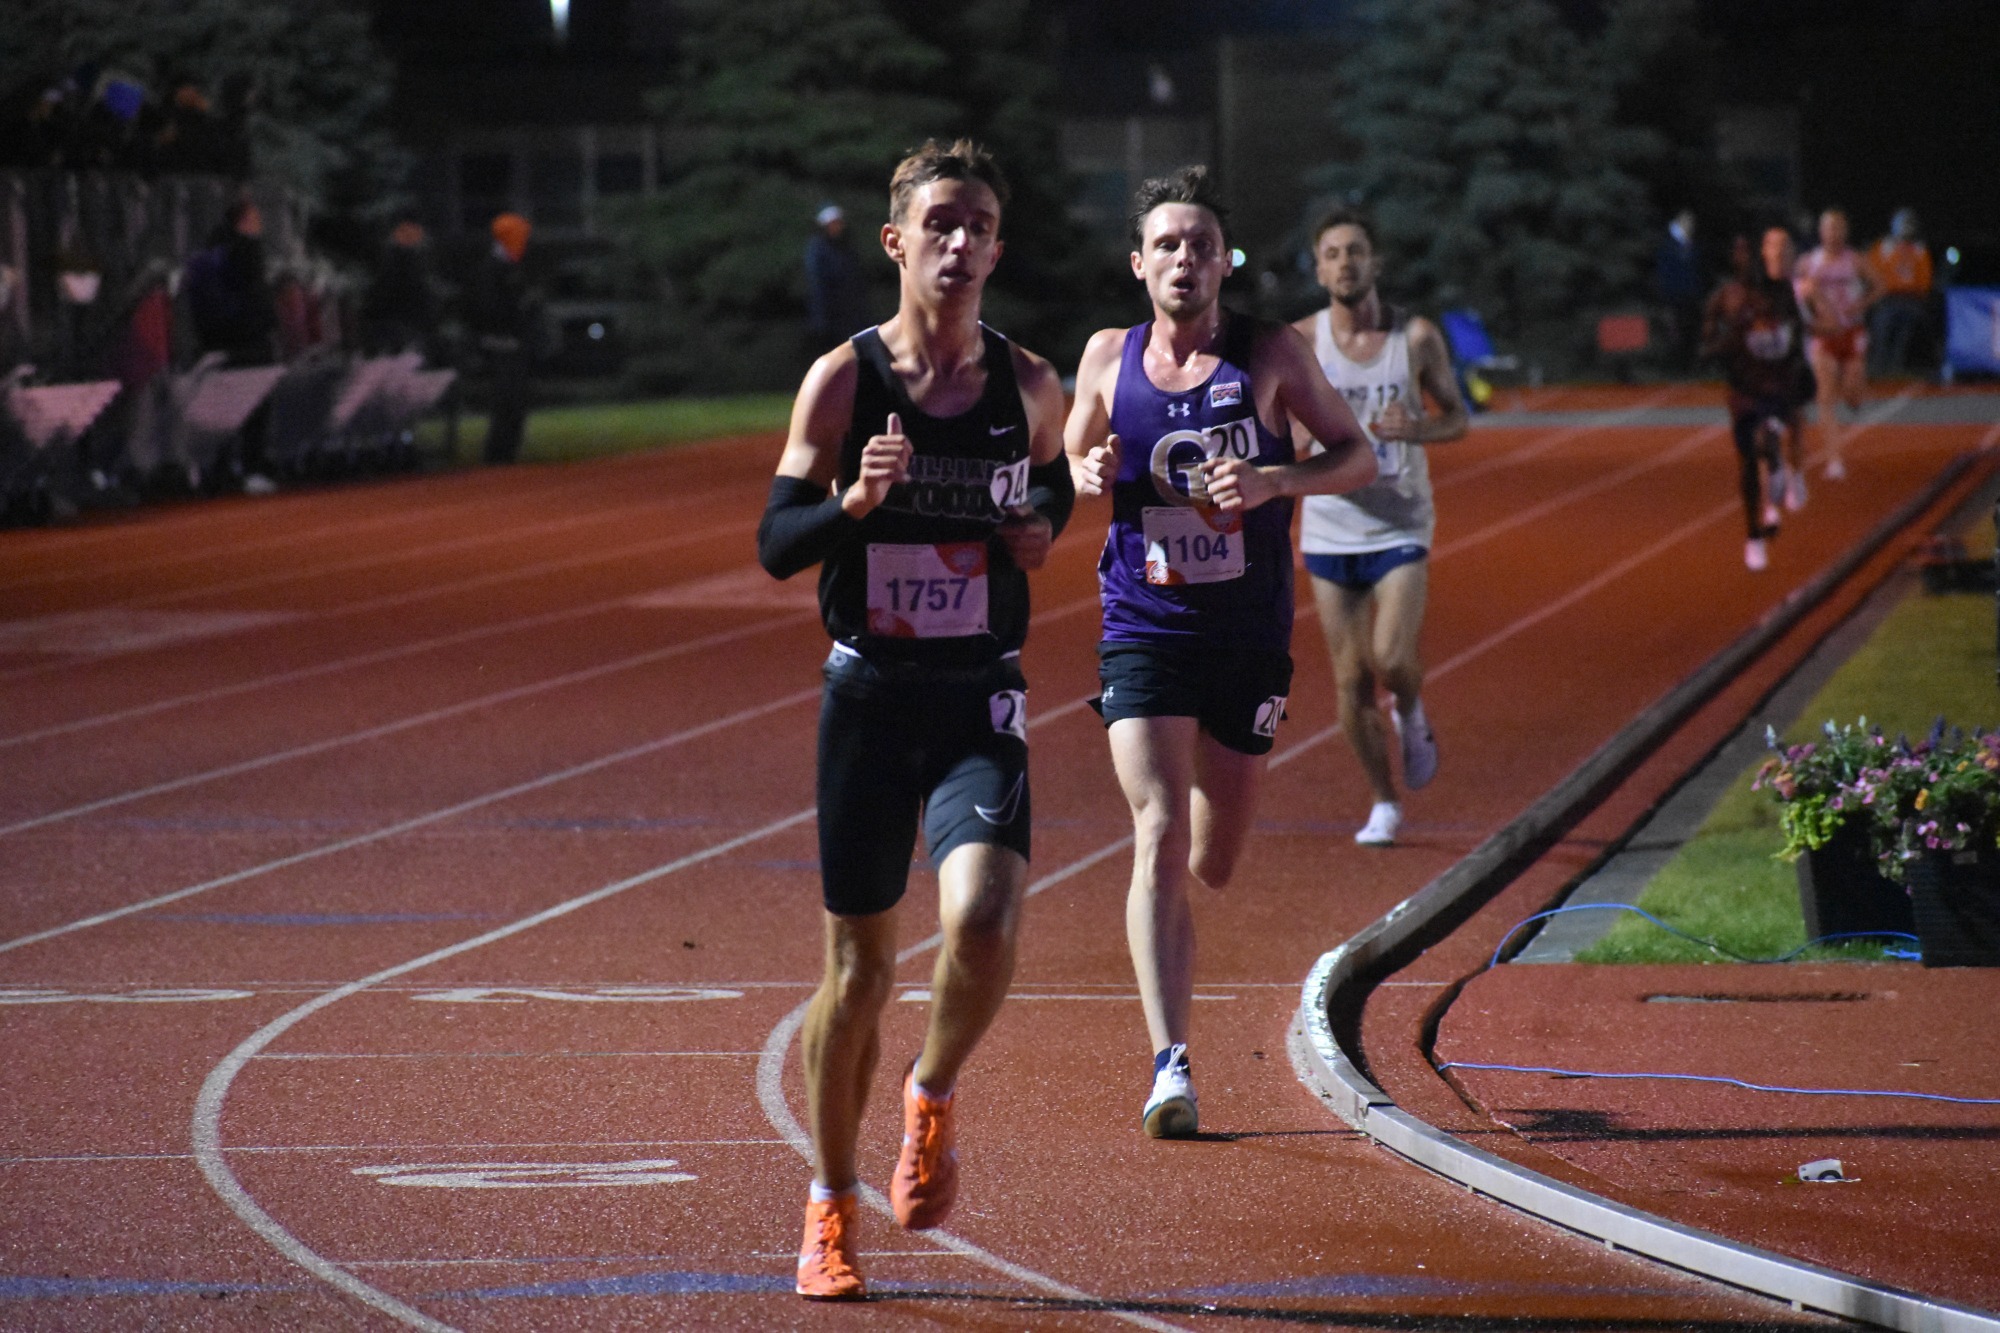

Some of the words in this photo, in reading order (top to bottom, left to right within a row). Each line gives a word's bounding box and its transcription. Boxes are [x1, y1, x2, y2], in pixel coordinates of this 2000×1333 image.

[1210, 423, 1249, 460] 20
[996, 463, 1026, 511] 24
[1150, 429, 1213, 508] G
[1158, 533, 1229, 563] 1104
[886, 577, 970, 612] 1757
